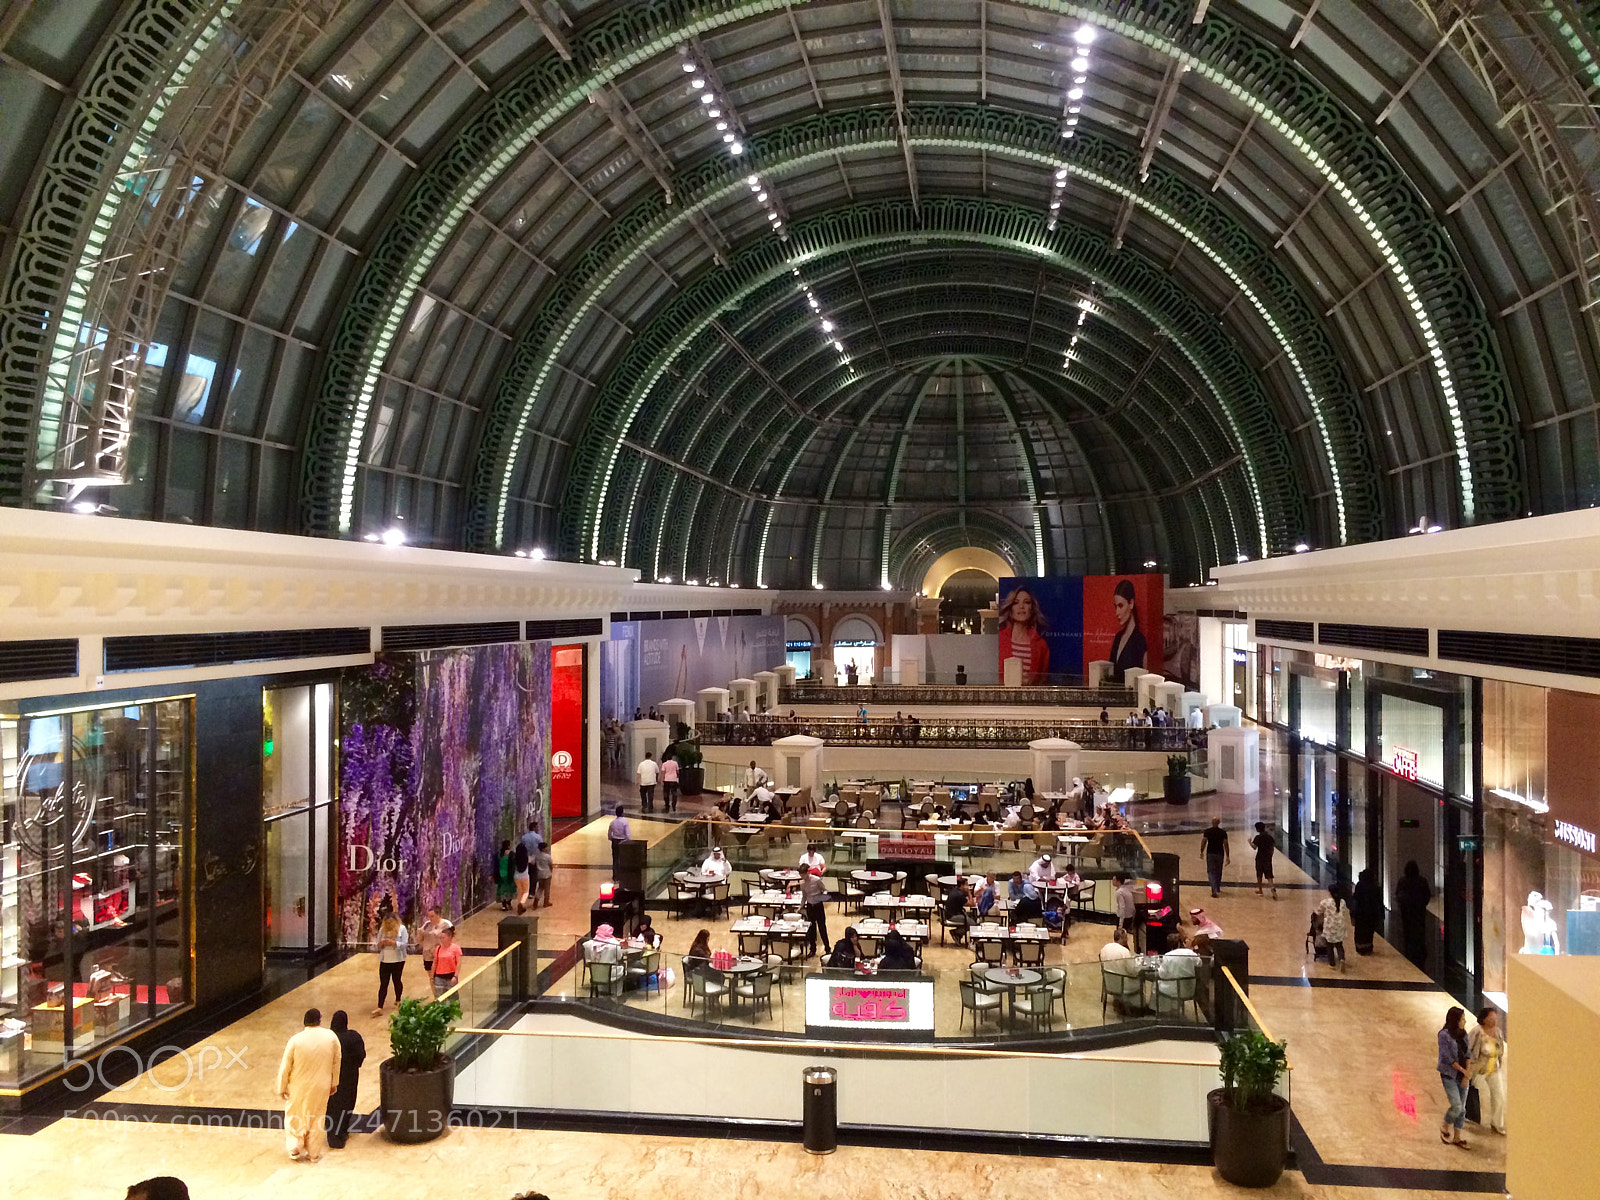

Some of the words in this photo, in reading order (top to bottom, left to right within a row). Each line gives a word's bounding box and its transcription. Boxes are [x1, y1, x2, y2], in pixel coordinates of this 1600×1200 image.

[347, 844, 407, 872] Dior
[442, 831, 464, 859] Dior
[880, 847, 933, 855] DALLOYAU
